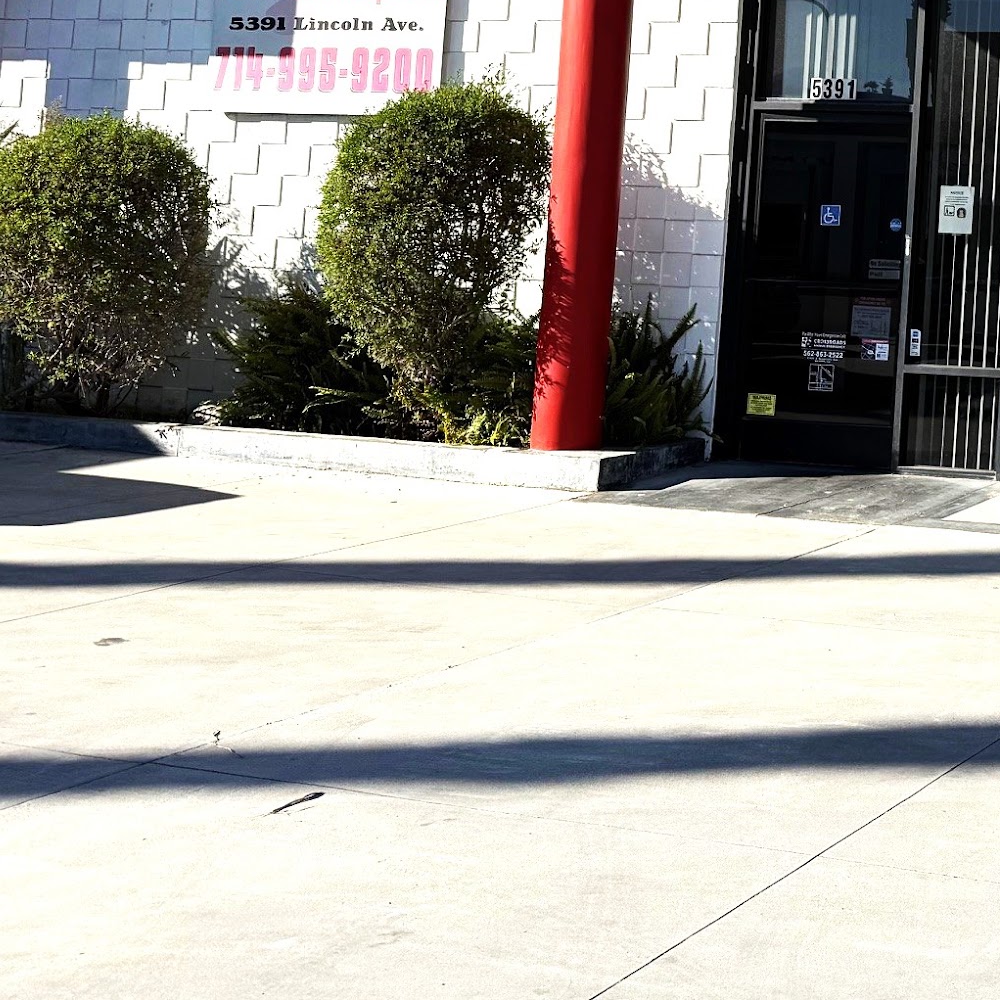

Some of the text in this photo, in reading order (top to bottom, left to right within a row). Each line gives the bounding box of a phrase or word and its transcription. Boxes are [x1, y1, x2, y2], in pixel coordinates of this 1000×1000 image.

[229, 16, 424, 31] 5391 Lincoln Ave.
[213, 46, 434, 94] 714-995-9200
[812, 79, 856, 99] 5391
